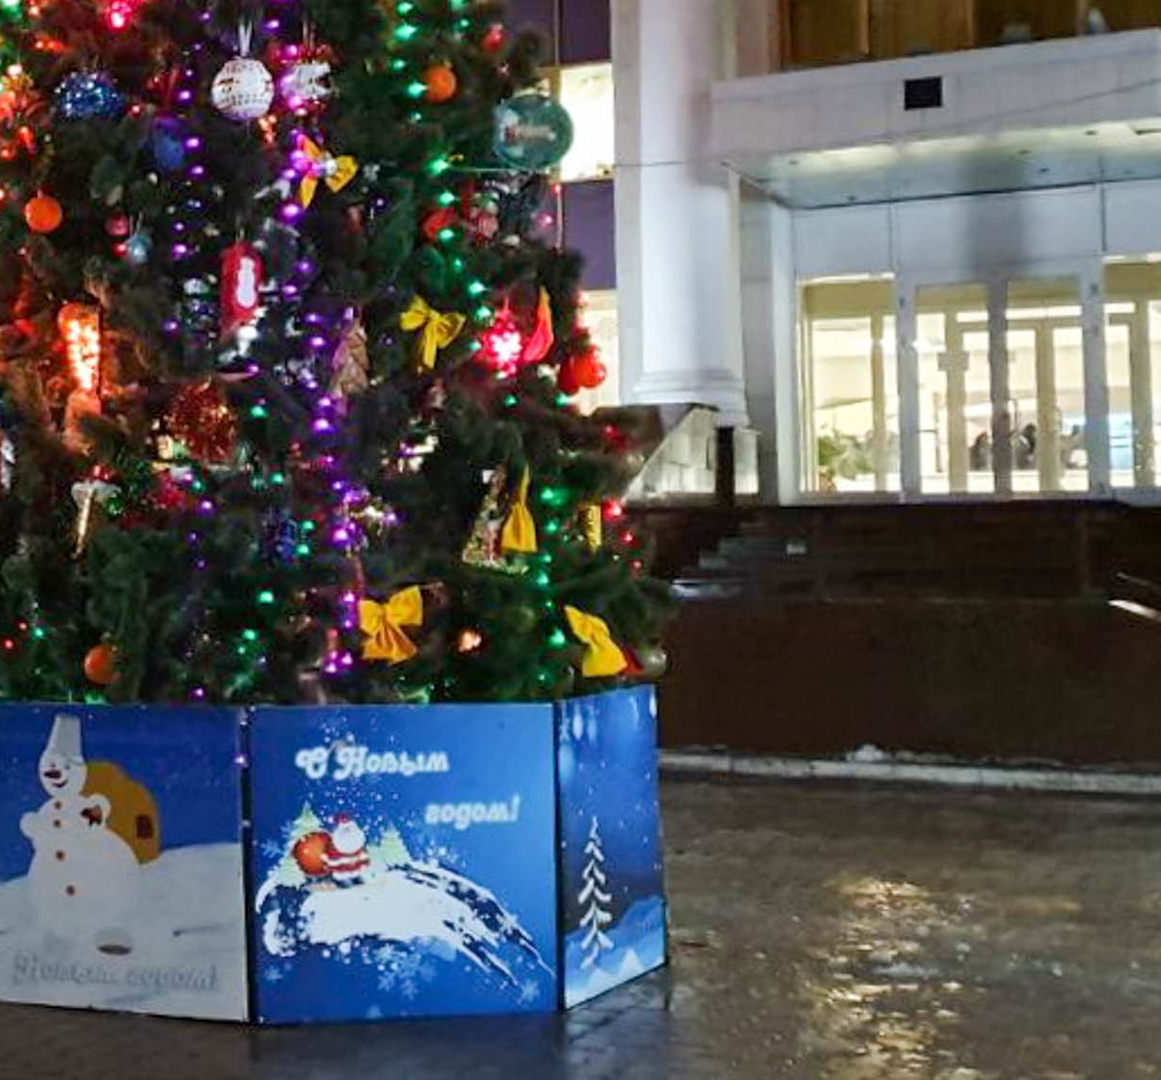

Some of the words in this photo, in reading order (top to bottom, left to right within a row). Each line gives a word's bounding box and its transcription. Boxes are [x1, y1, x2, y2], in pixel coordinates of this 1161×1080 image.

[295, 746, 329, 779] С
[334, 744, 449, 780] Новым
[425, 794, 520, 830] годом!
